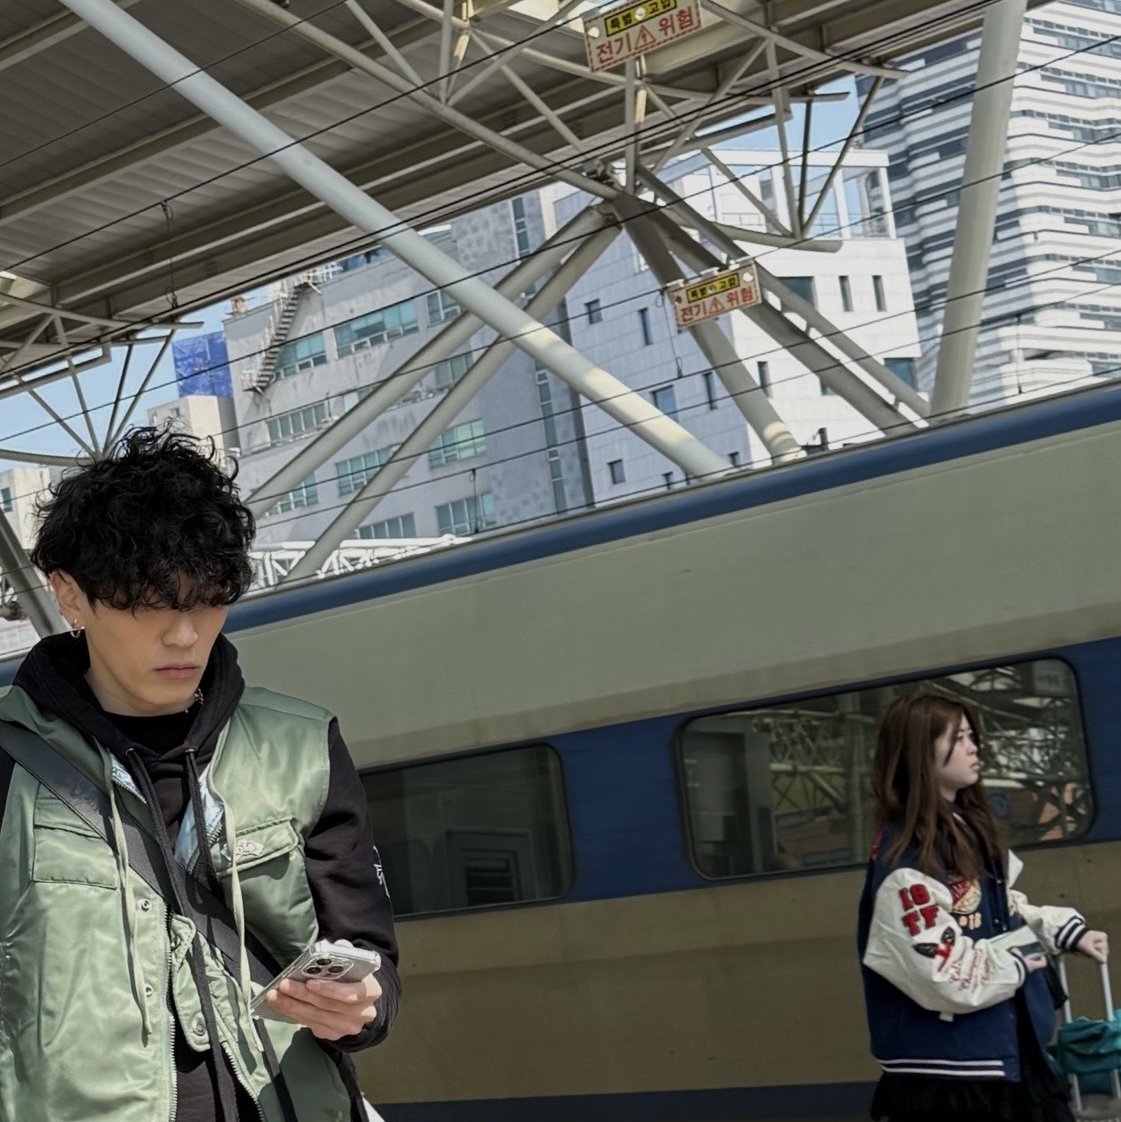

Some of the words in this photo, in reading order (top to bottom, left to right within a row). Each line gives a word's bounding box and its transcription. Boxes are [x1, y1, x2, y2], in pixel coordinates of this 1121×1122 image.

[596, 32, 632, 64] 전기
[659, 6, 694, 36] 위험
[681, 301, 707, 322] 전기
[726, 286, 754, 306] 위험
[901, 904, 940, 937] TF
